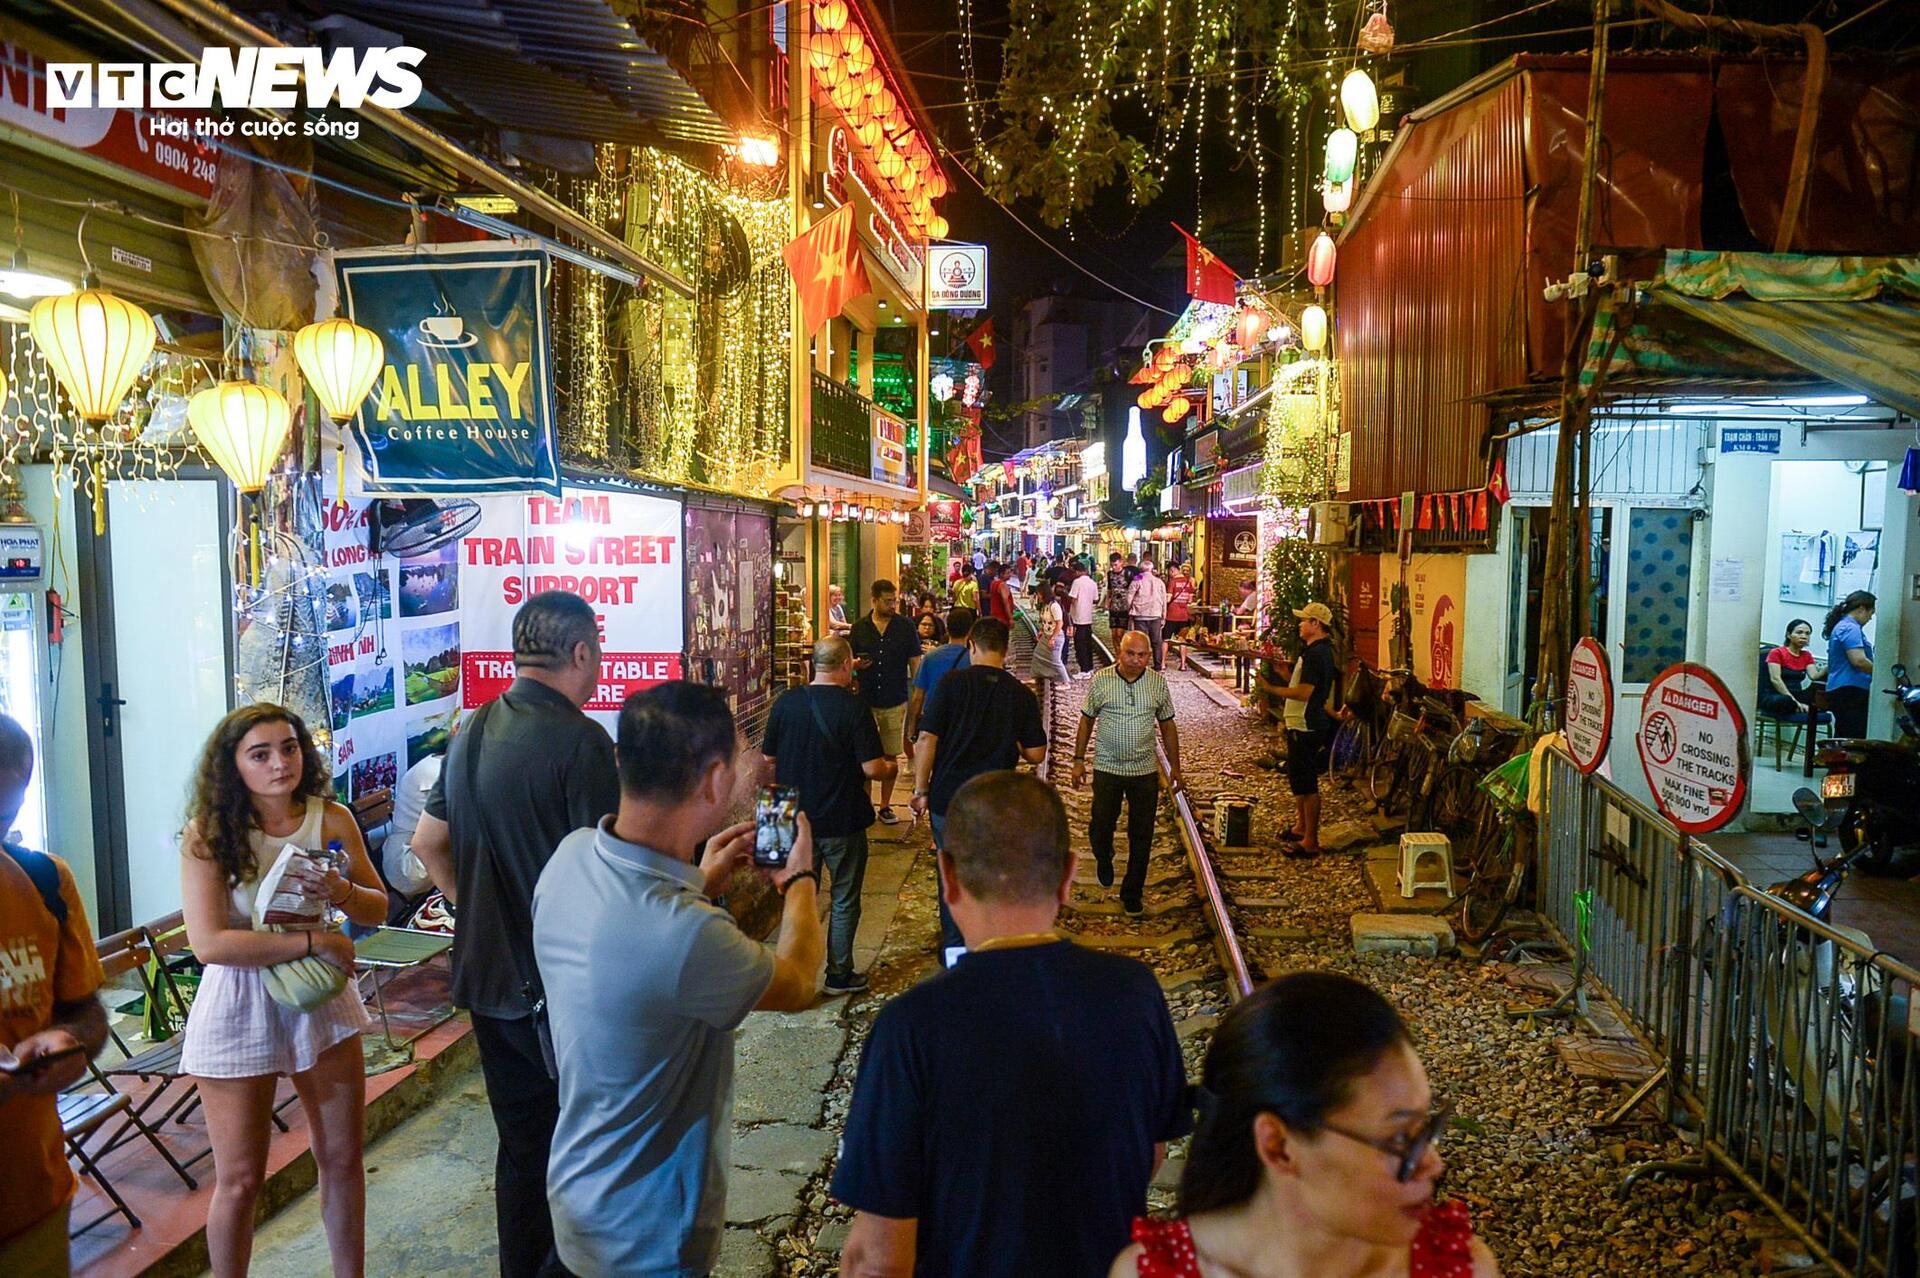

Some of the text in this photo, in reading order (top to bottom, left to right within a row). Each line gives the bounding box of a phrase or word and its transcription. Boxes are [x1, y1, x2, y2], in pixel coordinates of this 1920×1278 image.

[155, 141, 217, 184] 0904 248
[376, 362, 530, 421] ALLEY
[387, 425, 530, 440] Coffee House
[527, 496, 611, 525] TEAM
[331, 544, 366, 568] LONG
[463, 536, 555, 566] TRAIN
[564, 535, 676, 566] STREET
[600, 661, 669, 680] TABLE
[1671, 695, 1715, 715] DANGER
[1698, 731, 1714, 745] NO
[1681, 743, 1731, 768] CROSSING
[1676, 757, 1736, 787] THE TRACKS
[1664, 776, 1706, 801] MAX FINE
[1692, 803, 1710, 816] vnd
